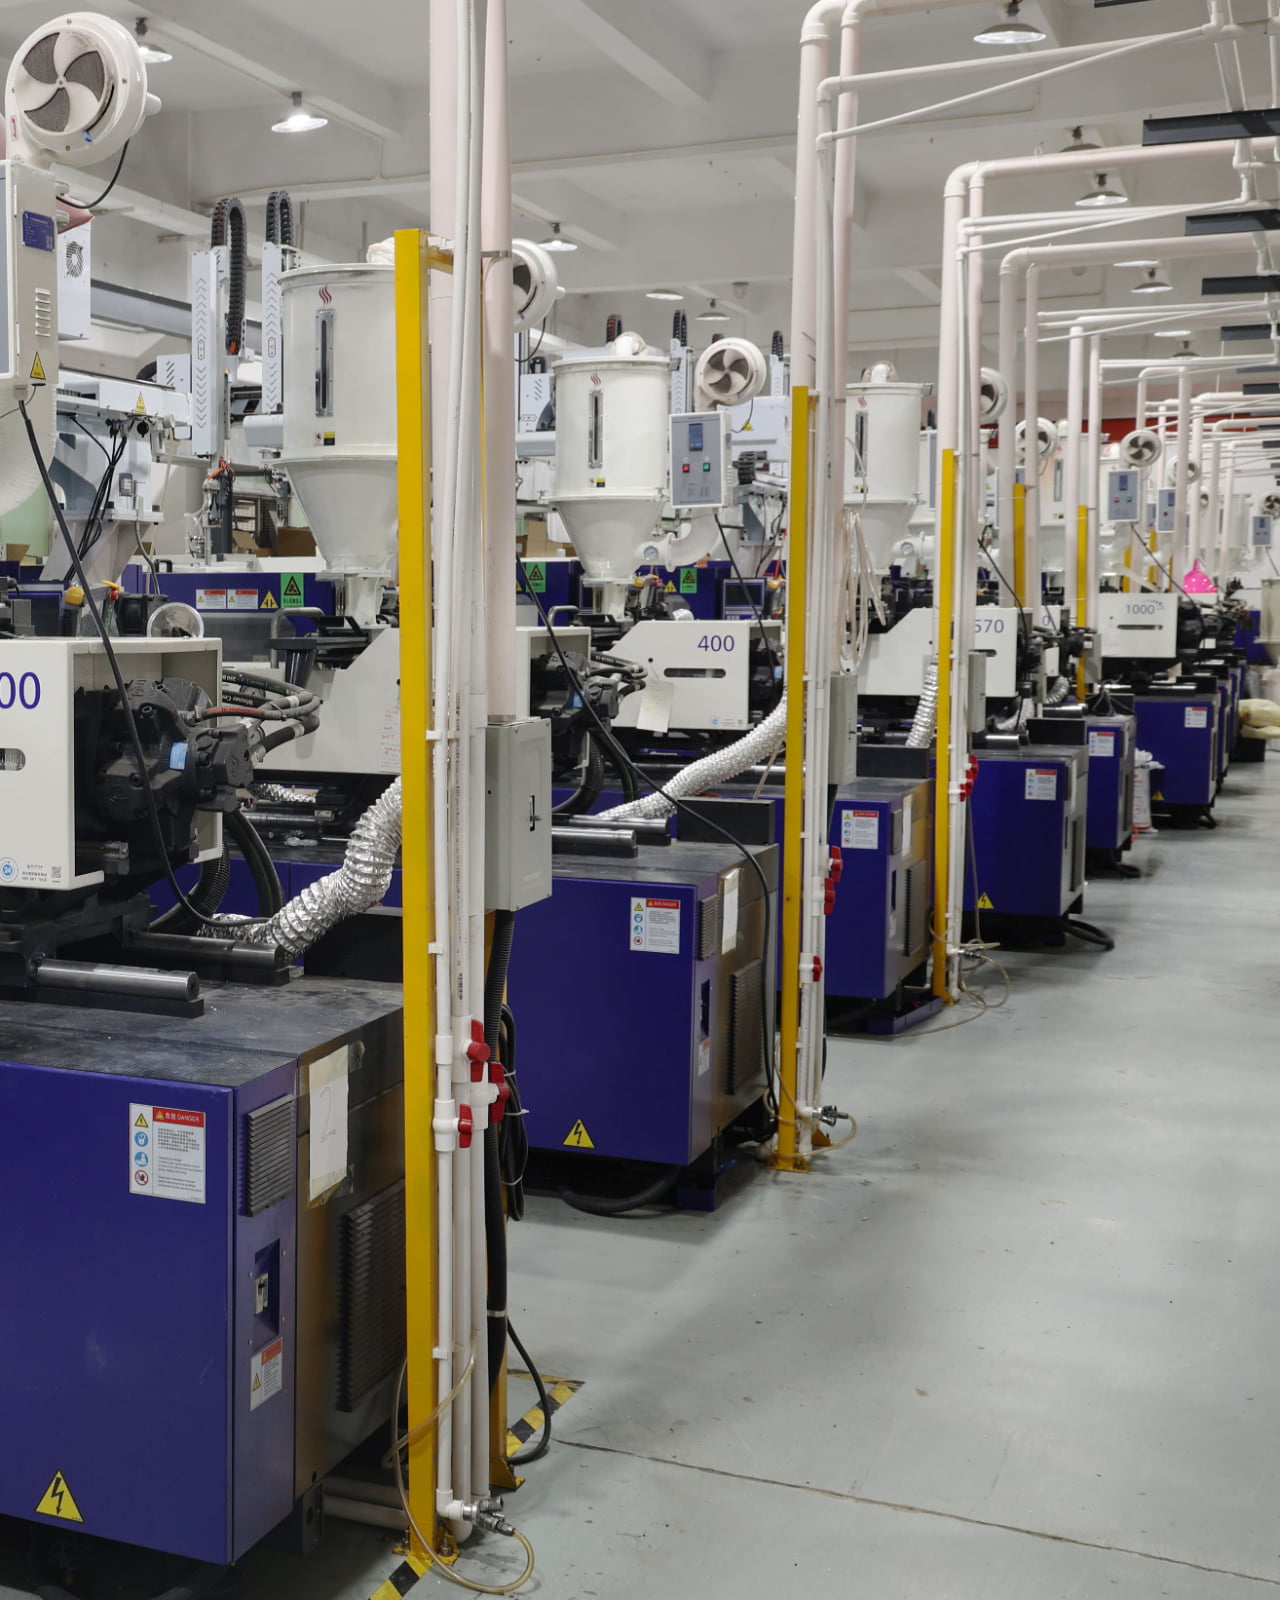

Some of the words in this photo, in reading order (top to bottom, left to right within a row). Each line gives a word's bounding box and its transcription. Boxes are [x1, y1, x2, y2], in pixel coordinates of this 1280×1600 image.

[1126, 604, 1155, 615] 1000
[697, 634, 735, 652] 400
[176, 1113, 200, 1123] DANGER
